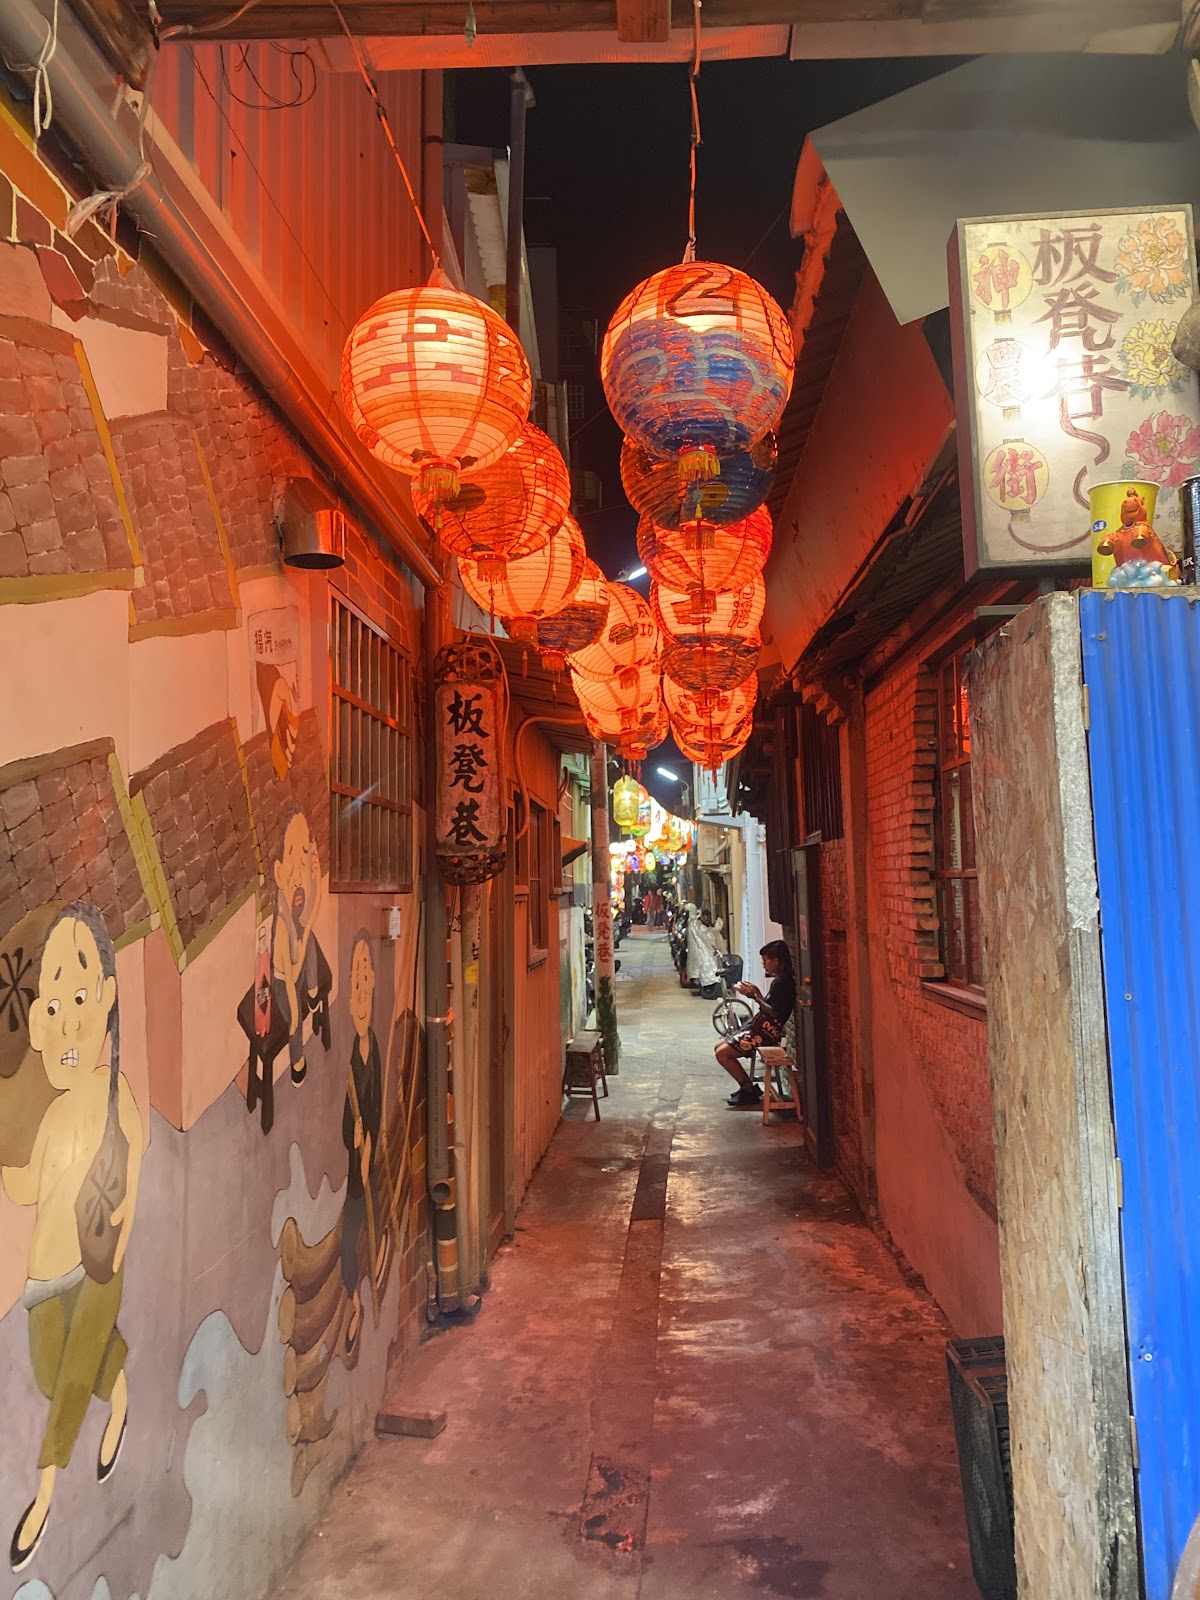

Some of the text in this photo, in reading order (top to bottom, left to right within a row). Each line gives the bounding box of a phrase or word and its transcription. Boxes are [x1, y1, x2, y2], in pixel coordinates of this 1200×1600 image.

[974, 249, 1043, 504] 神農街
[446, 689, 490, 847] 板凳巷
[594, 902, 614, 964] 板凳巷
